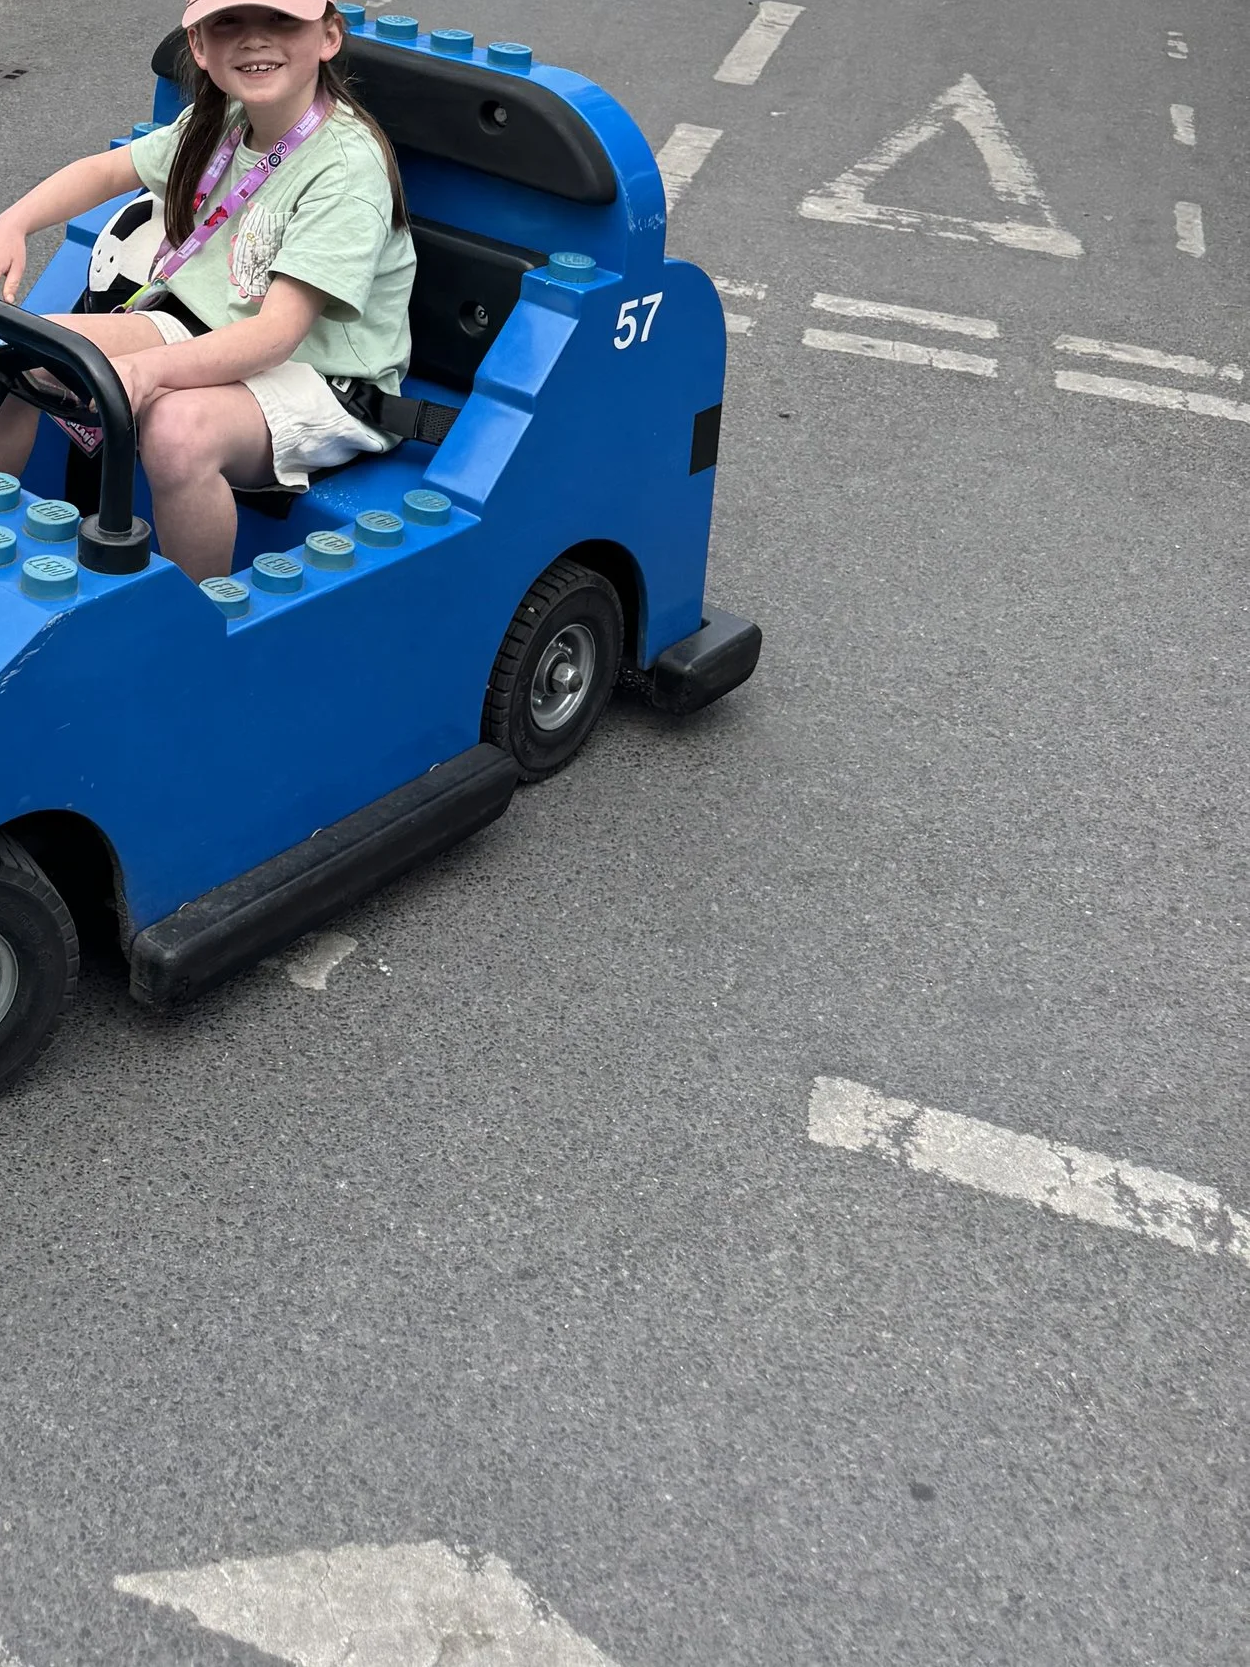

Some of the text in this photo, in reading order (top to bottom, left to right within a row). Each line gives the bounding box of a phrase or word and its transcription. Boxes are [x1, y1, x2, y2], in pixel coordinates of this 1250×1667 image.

[613, 291, 663, 350] 57
[31, 502, 75, 521] LEGO
[311, 533, 352, 551] LEGO
[29, 557, 74, 576] LEGO
[258, 555, 301, 574] LEGO
